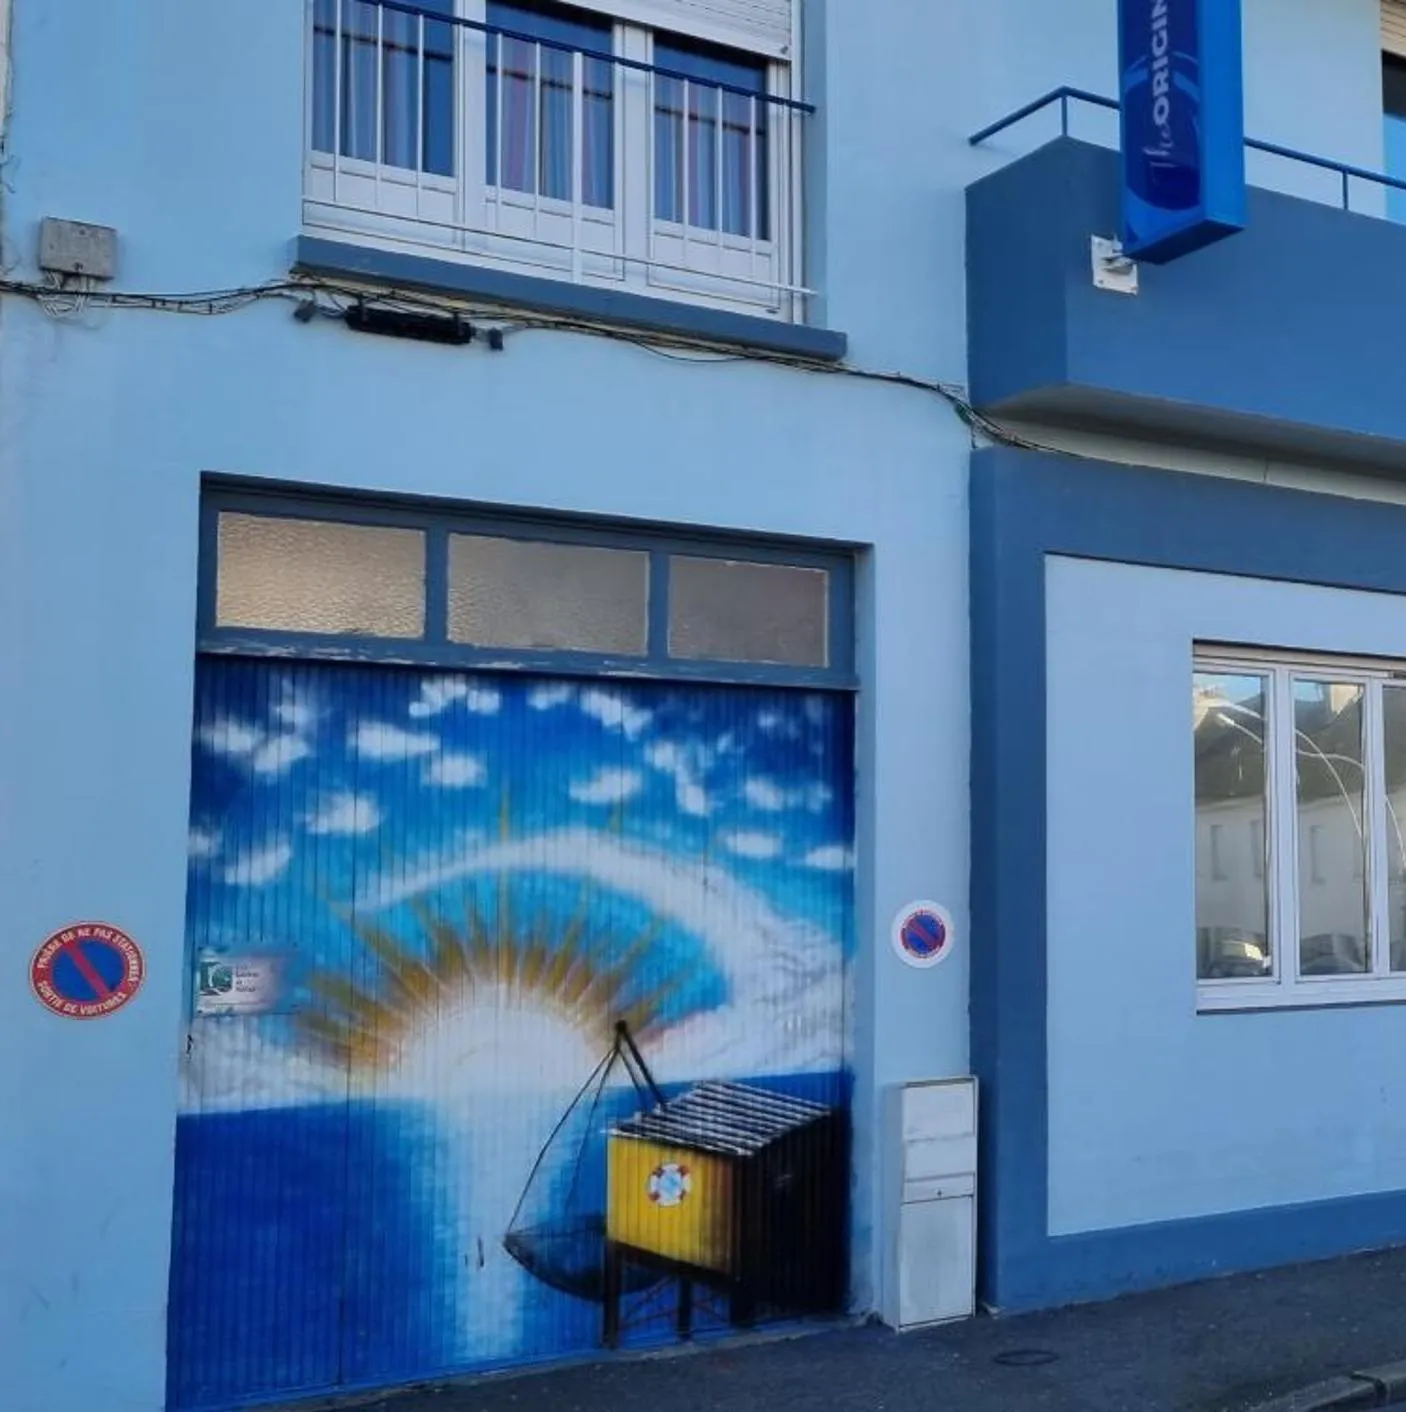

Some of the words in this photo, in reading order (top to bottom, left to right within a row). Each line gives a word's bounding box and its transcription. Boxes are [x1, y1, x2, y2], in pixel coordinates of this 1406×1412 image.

[77, 927, 91, 938] NE
[93, 927, 114, 939] PAS
[37, 979, 62, 1008] SORTIE
[63, 1003, 77, 1014] DE
